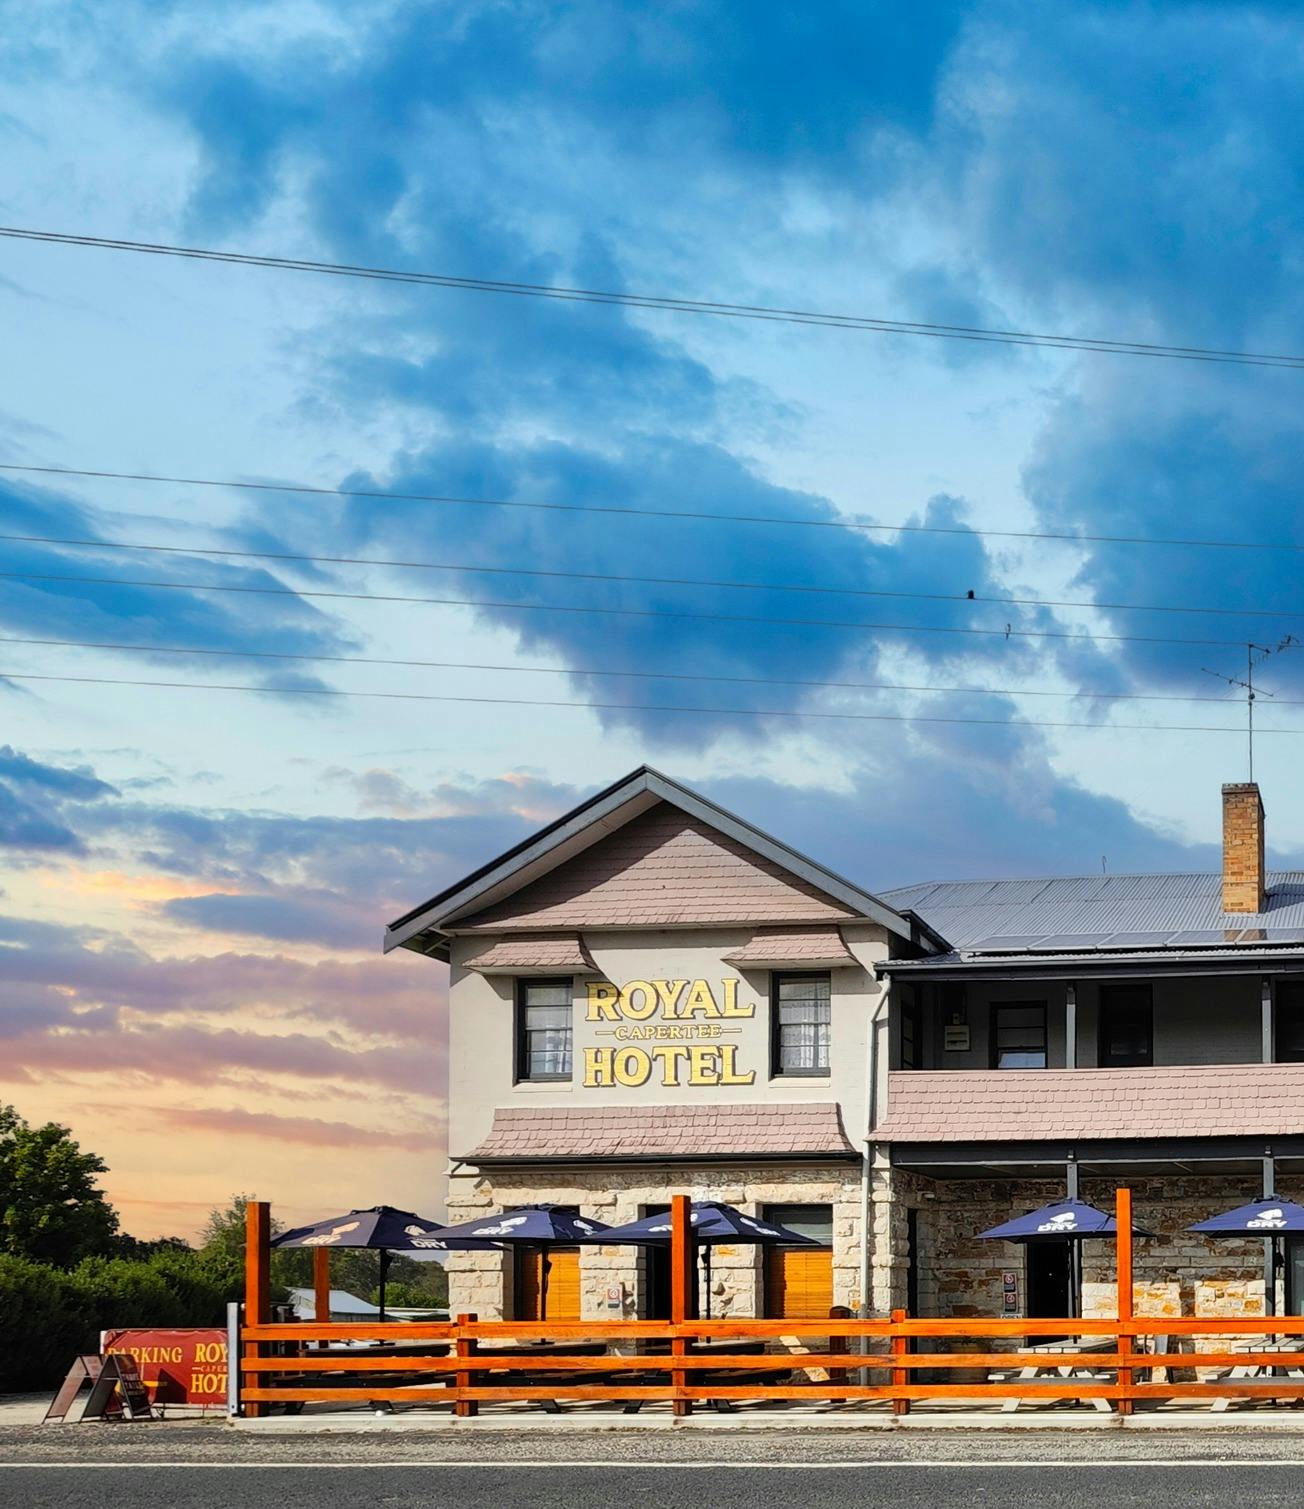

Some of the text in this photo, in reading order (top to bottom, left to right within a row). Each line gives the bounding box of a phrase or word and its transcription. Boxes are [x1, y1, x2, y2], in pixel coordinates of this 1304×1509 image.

[585, 978, 756, 1021] ROYAL
[615, 1024, 722, 1041] CAPERTEE
[583, 1045, 757, 1087] HOTEL
[1037, 1223, 1078, 1232] DRY
[1246, 1220, 1288, 1228] DRY
[410, 1239, 447, 1249] DRY
